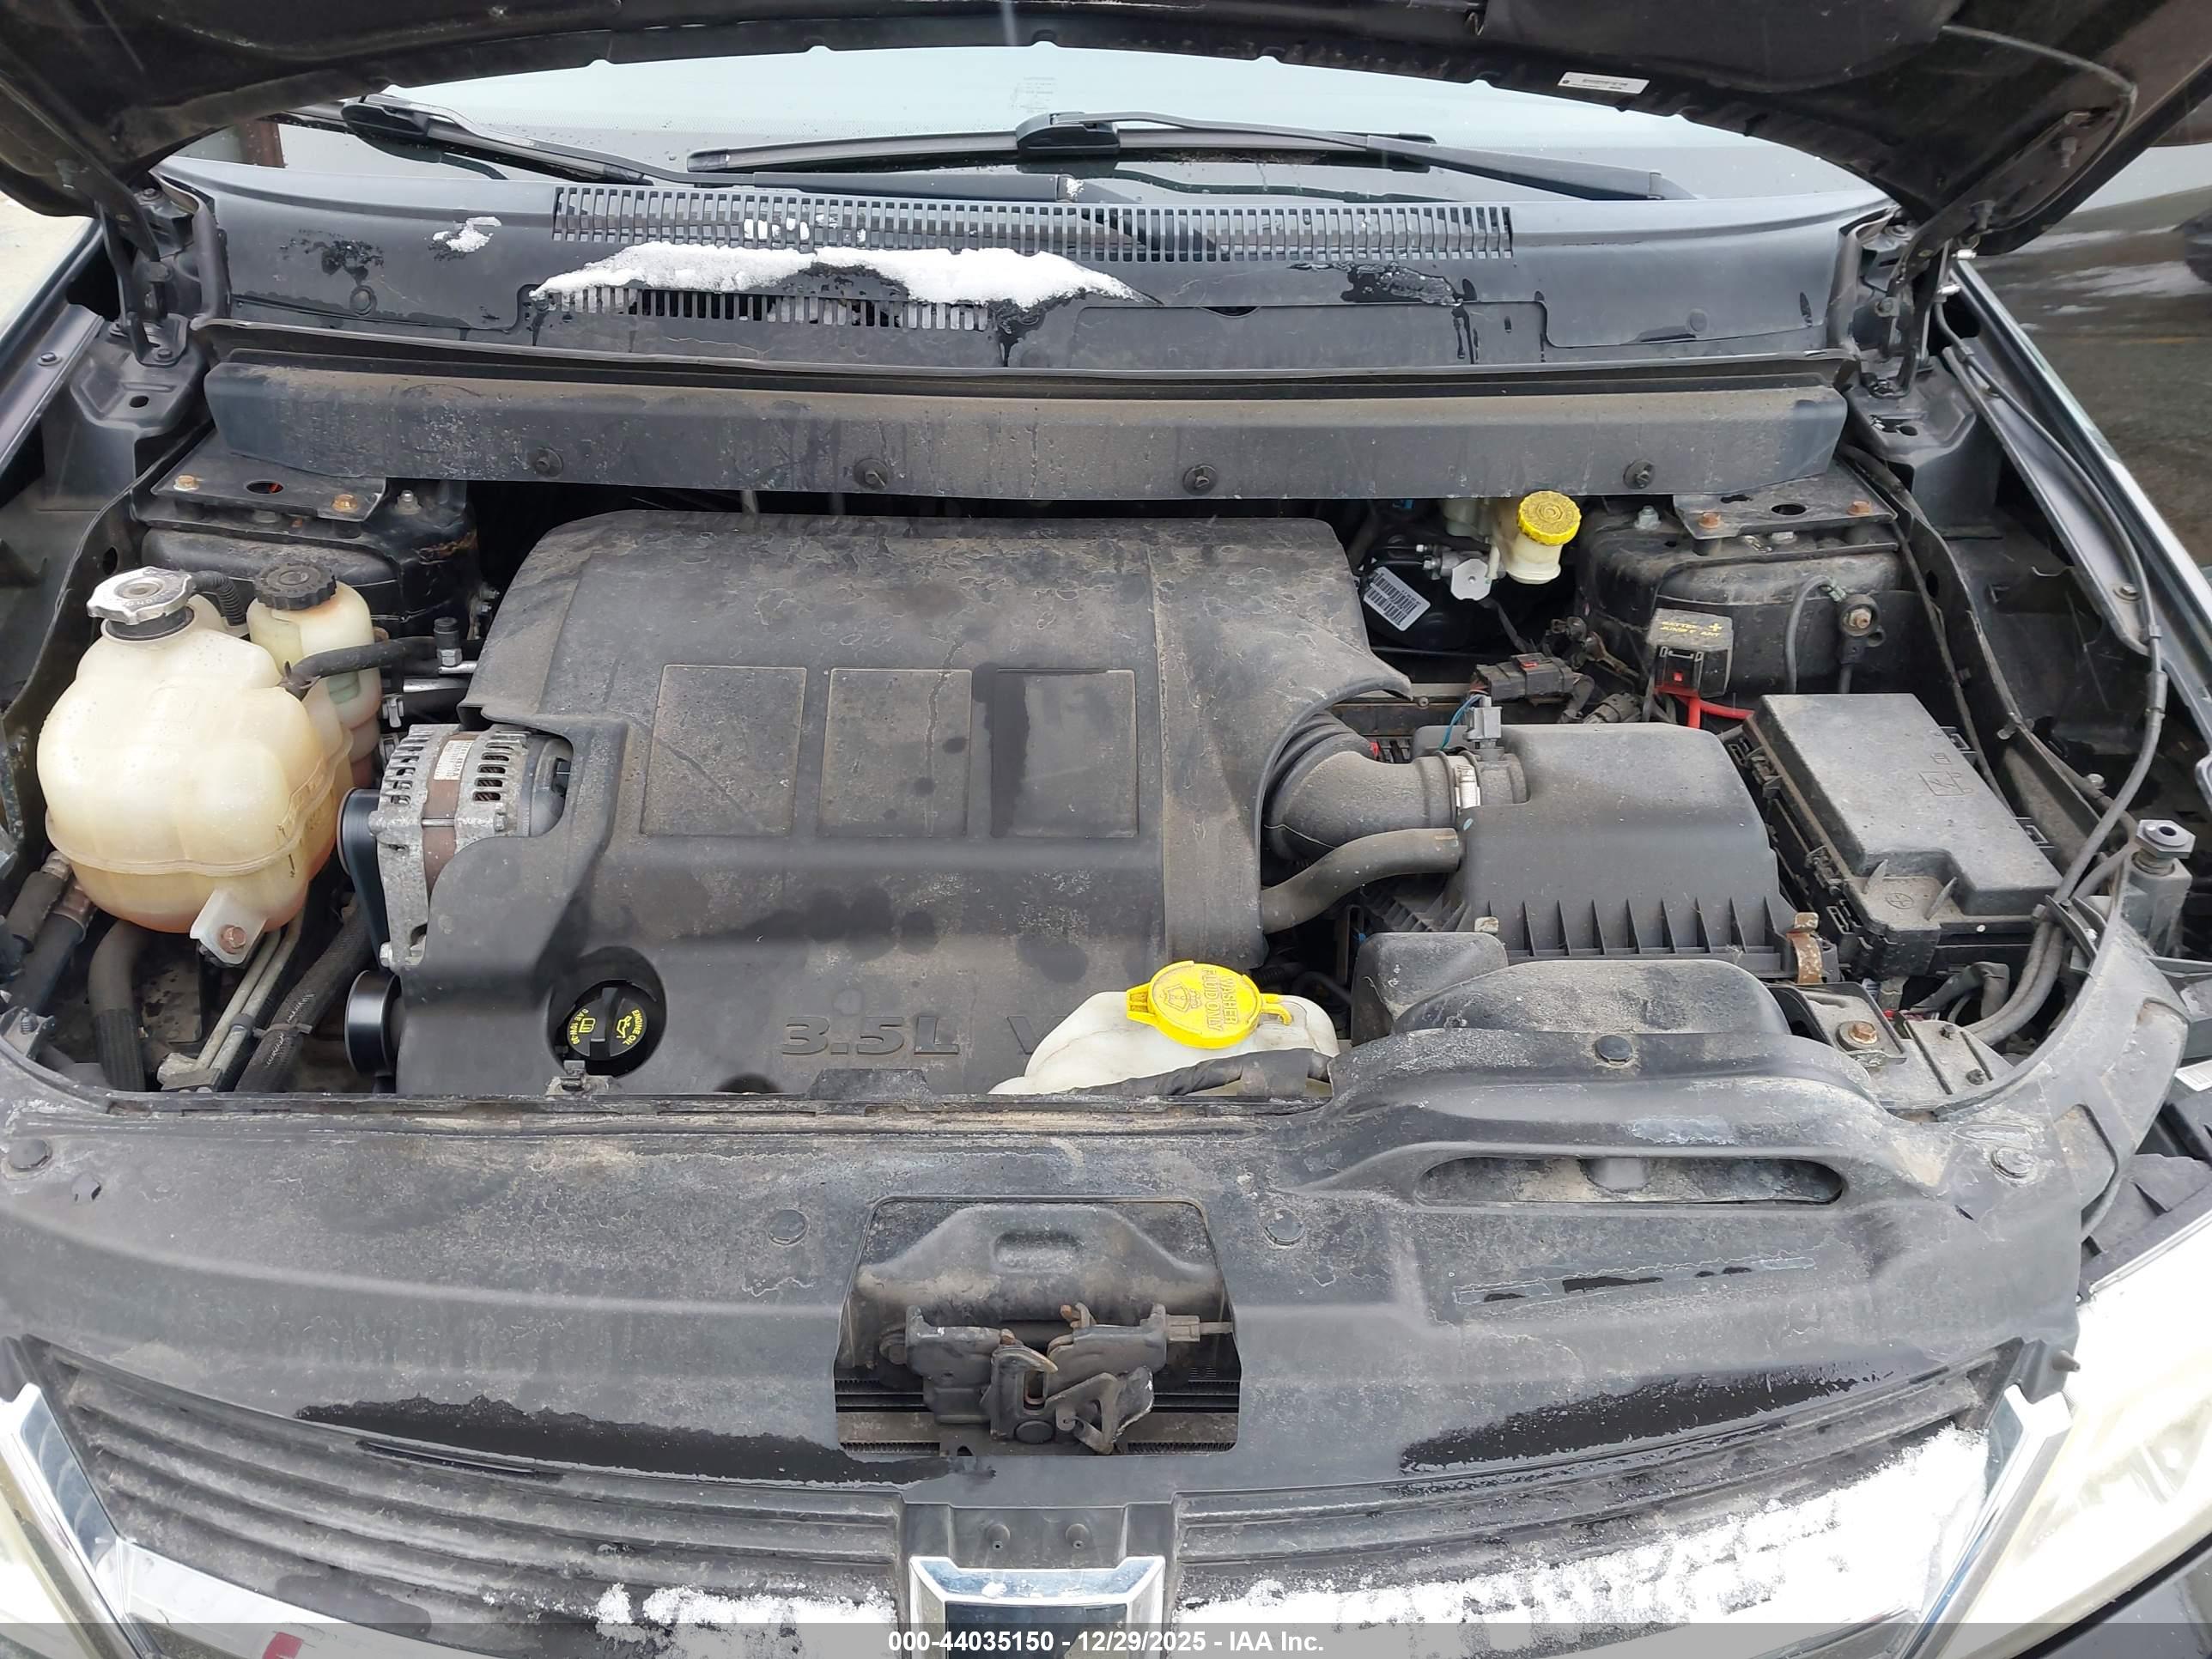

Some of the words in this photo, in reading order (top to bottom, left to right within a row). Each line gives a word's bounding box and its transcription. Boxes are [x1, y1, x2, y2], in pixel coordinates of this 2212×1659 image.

[1202, 968, 1219, 1000] FLUID
[1221, 976, 1238, 1024] WASHER
[631, 1009, 643, 1036] ENGINE
[1205, 1001, 1223, 1030] ONLY
[623, 1035, 636, 1046] OIL
[781, 1016, 959, 1055] 3.5L
